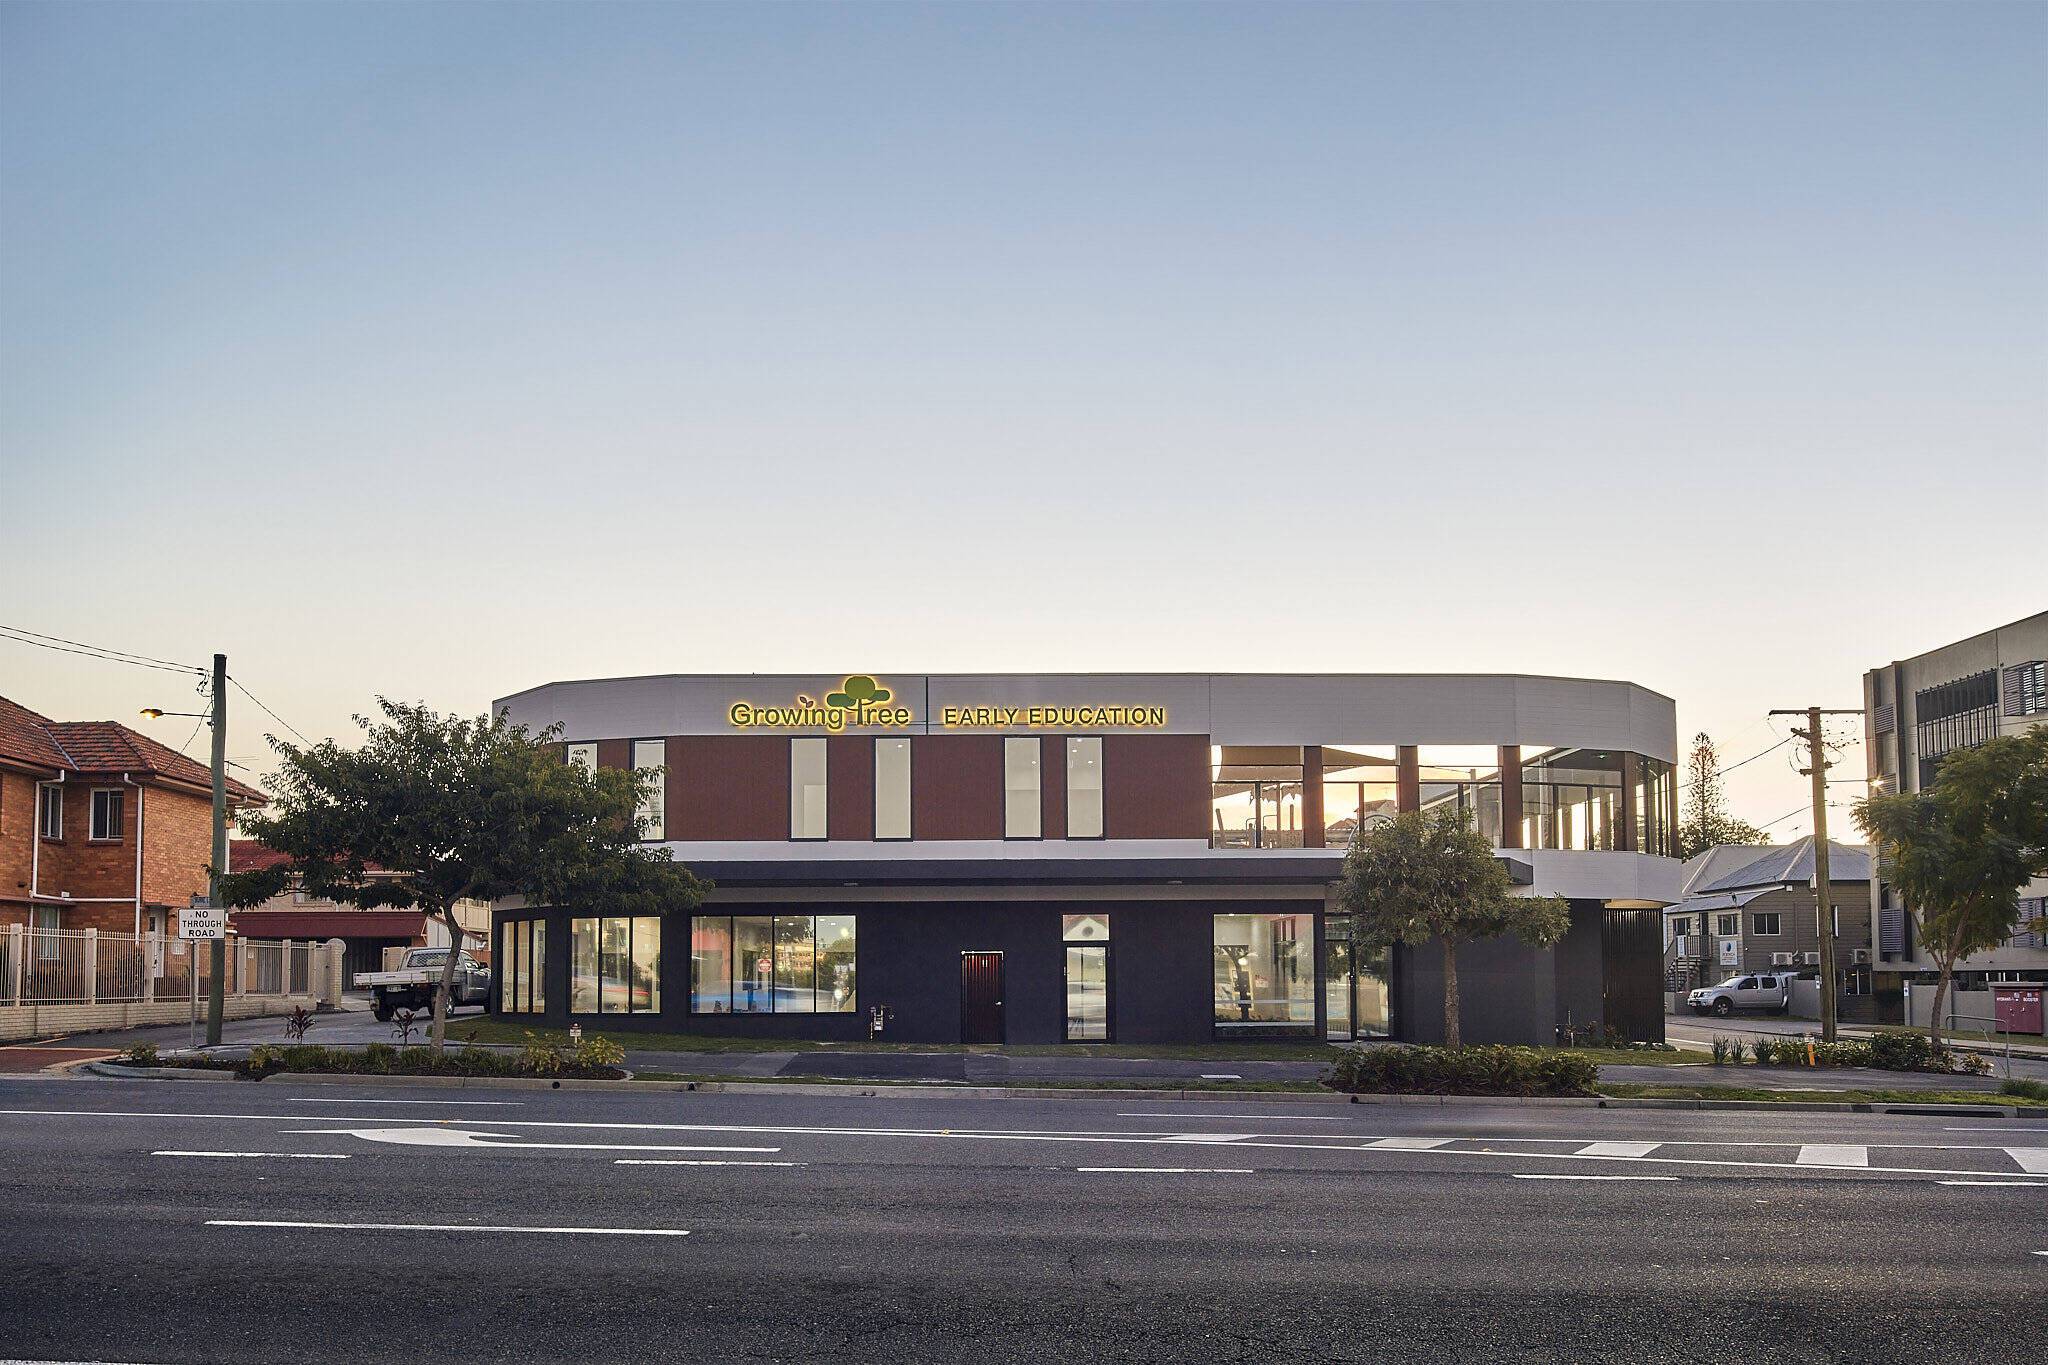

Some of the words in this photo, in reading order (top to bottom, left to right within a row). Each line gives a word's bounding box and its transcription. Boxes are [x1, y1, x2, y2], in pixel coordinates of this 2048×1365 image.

[730, 698, 844, 730] Growing
[943, 707, 1019, 725] EARLY
[1028, 707, 1165, 725] EDUCATION
[195, 910, 209, 919] NO
[182, 920, 222, 928] THROUGH
[188, 929, 215, 937] ROAD
